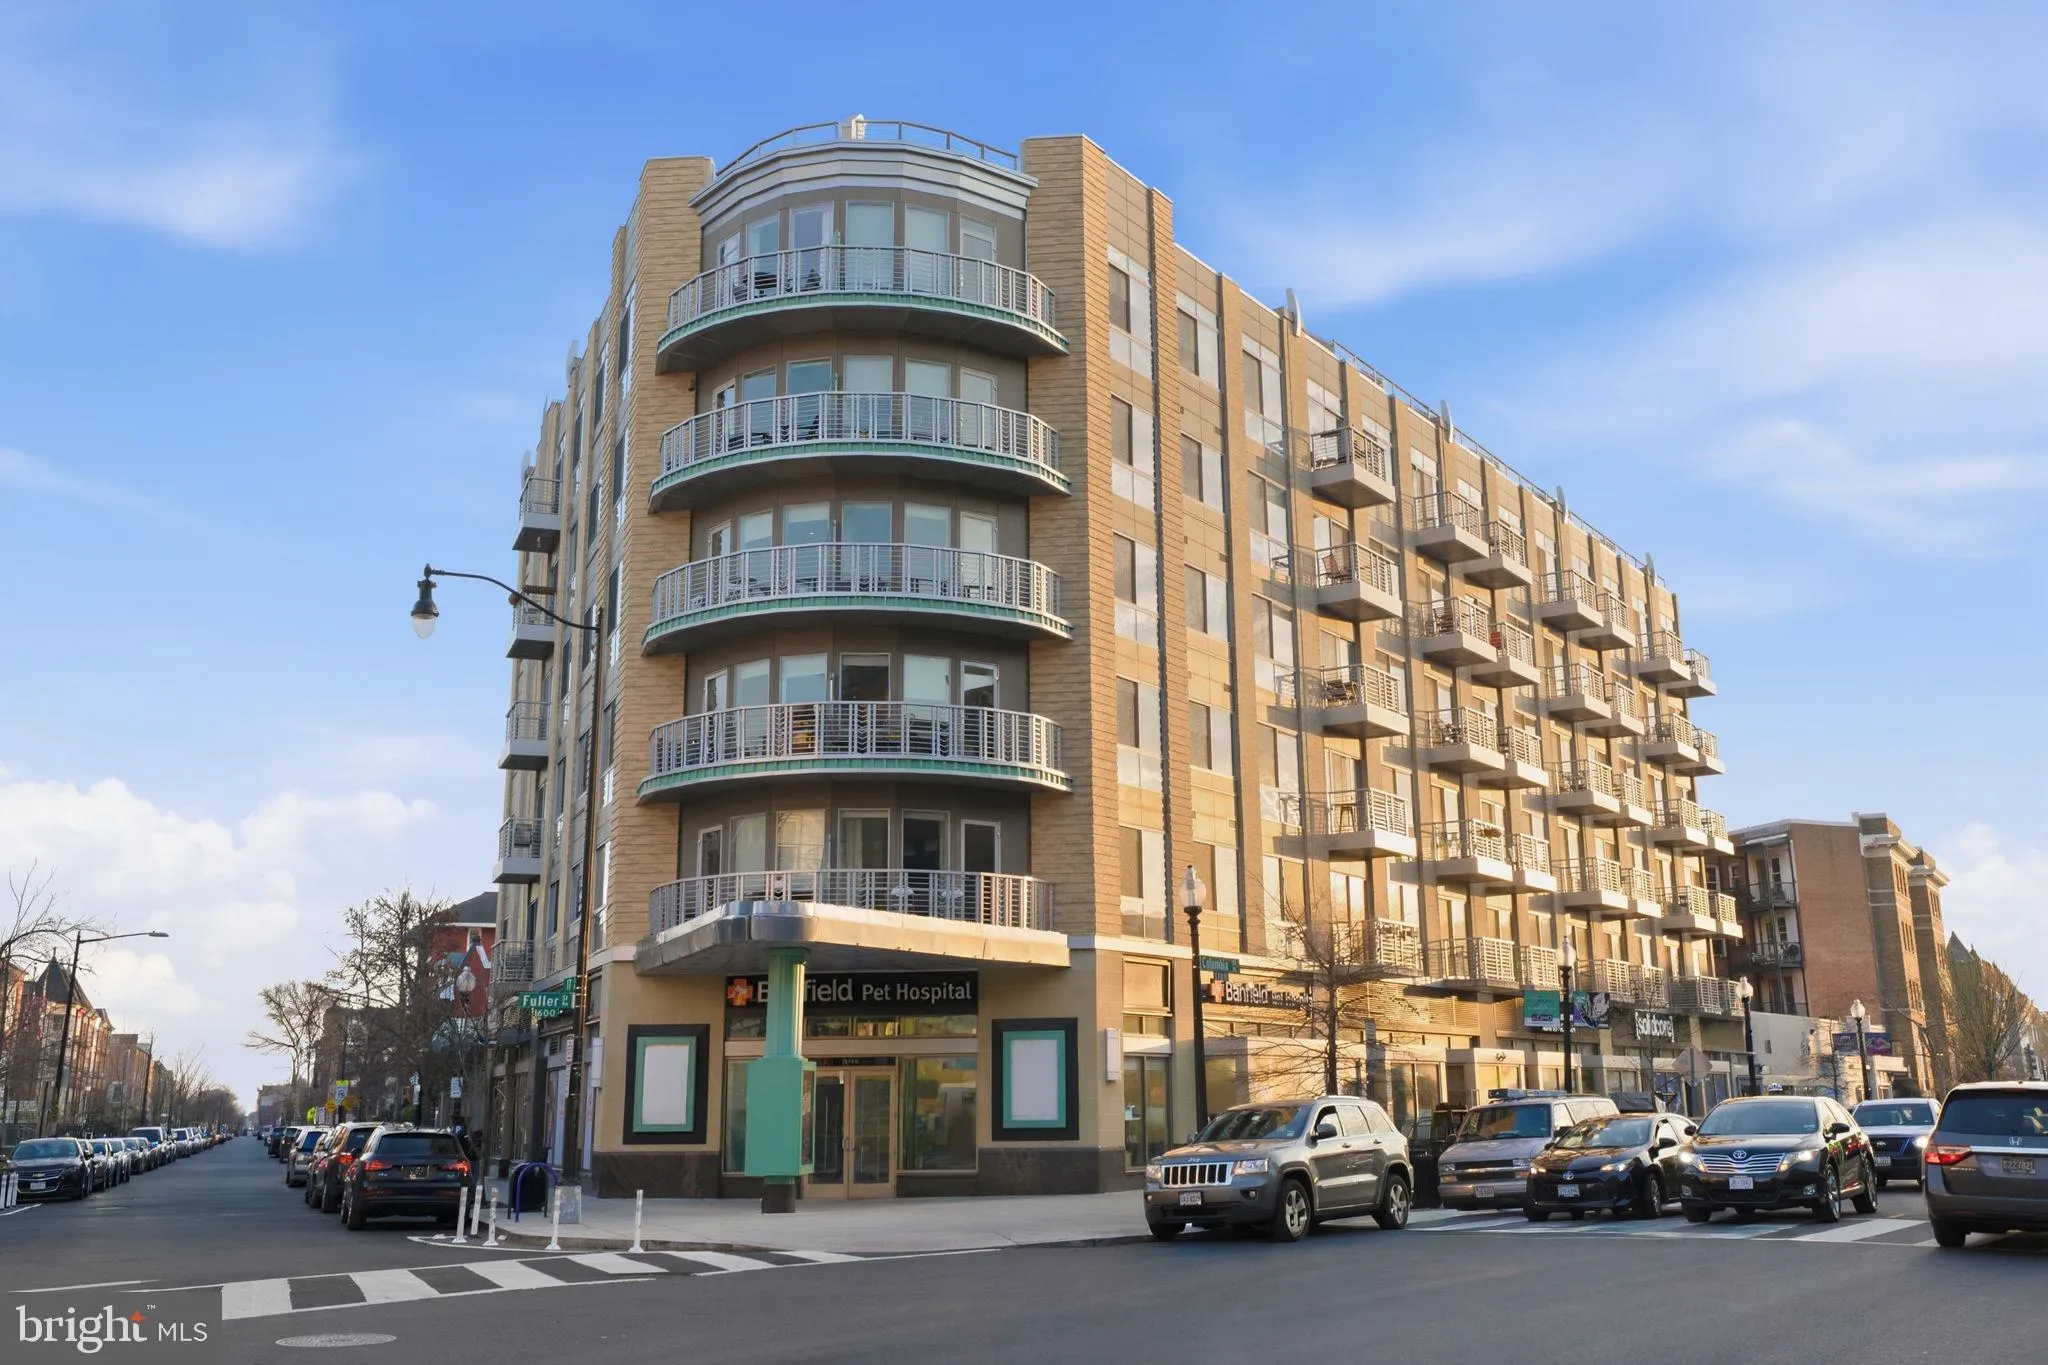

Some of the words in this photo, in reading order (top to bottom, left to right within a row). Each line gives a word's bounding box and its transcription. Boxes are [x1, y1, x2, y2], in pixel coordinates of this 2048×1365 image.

[523, 994, 559, 1007] Fuller
[757, 978, 853, 1003] Bfield
[862, 983, 890, 1000] Pet
[897, 982, 972, 1004] Hospital
